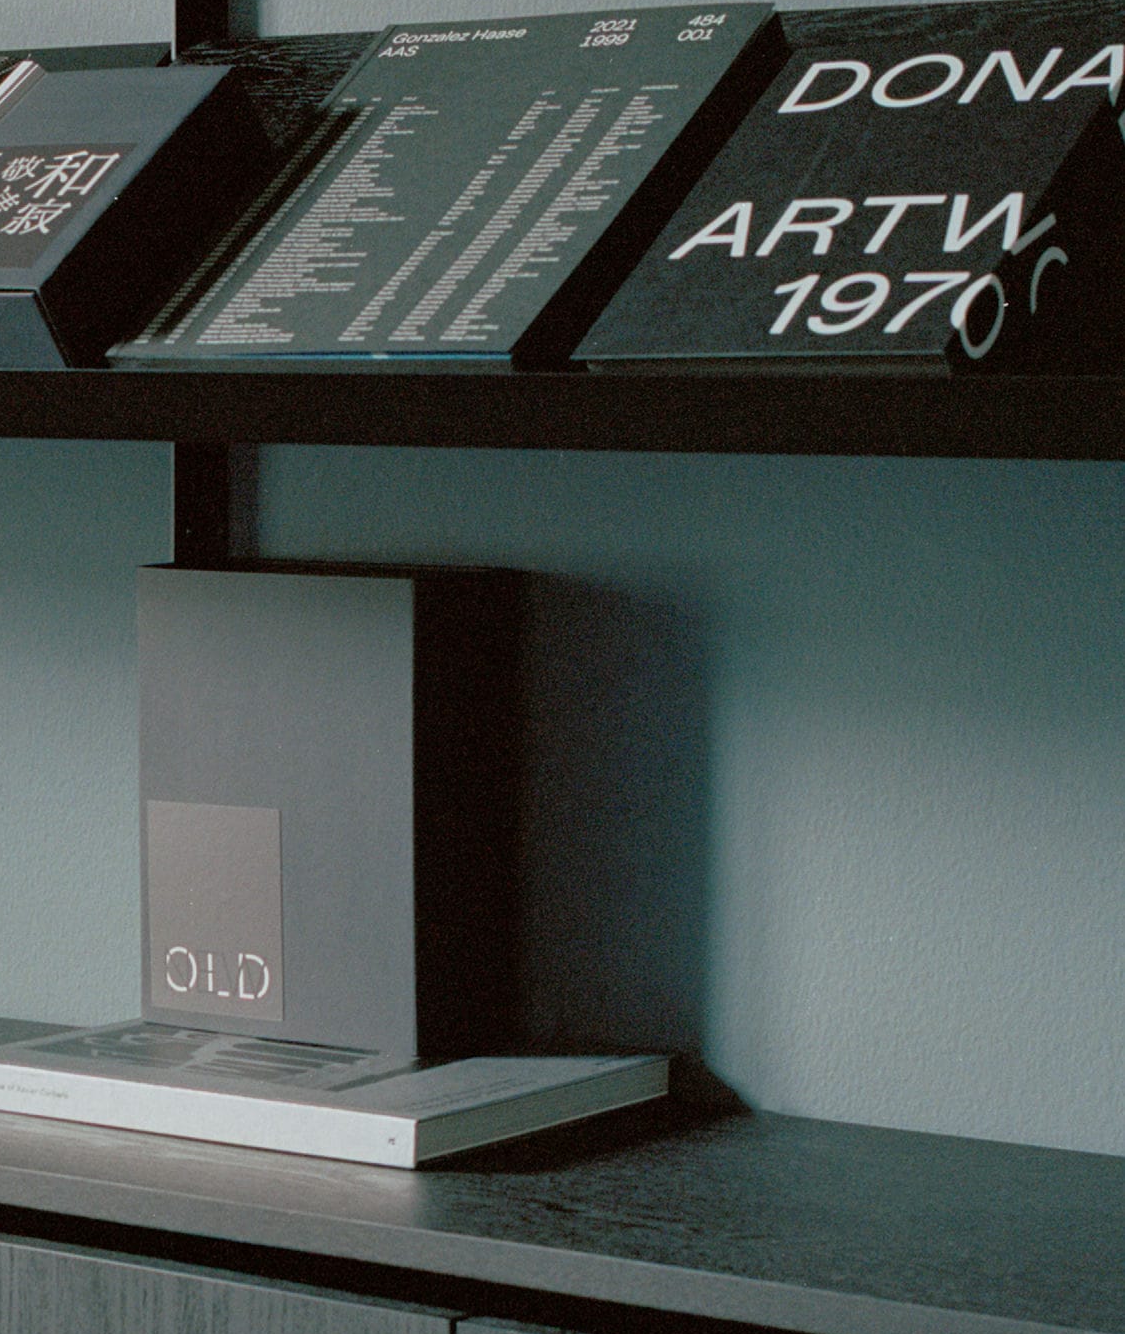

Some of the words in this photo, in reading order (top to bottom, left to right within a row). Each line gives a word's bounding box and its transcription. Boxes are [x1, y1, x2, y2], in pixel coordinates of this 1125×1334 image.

[589, 18, 637, 33] 2021
[688, 13, 726, 27] 484
[391, 30, 472, 45] Gonzalez
[472, 28, 527, 41] Haase
[578, 33, 629, 48] 1999
[677, 28, 713, 42] 001
[378, 45, 419, 58] AAS
[777, 43, 1125, 144] DONA
[769, 271, 1005, 360] 1970
[166, 946, 270, 1000] OLD
